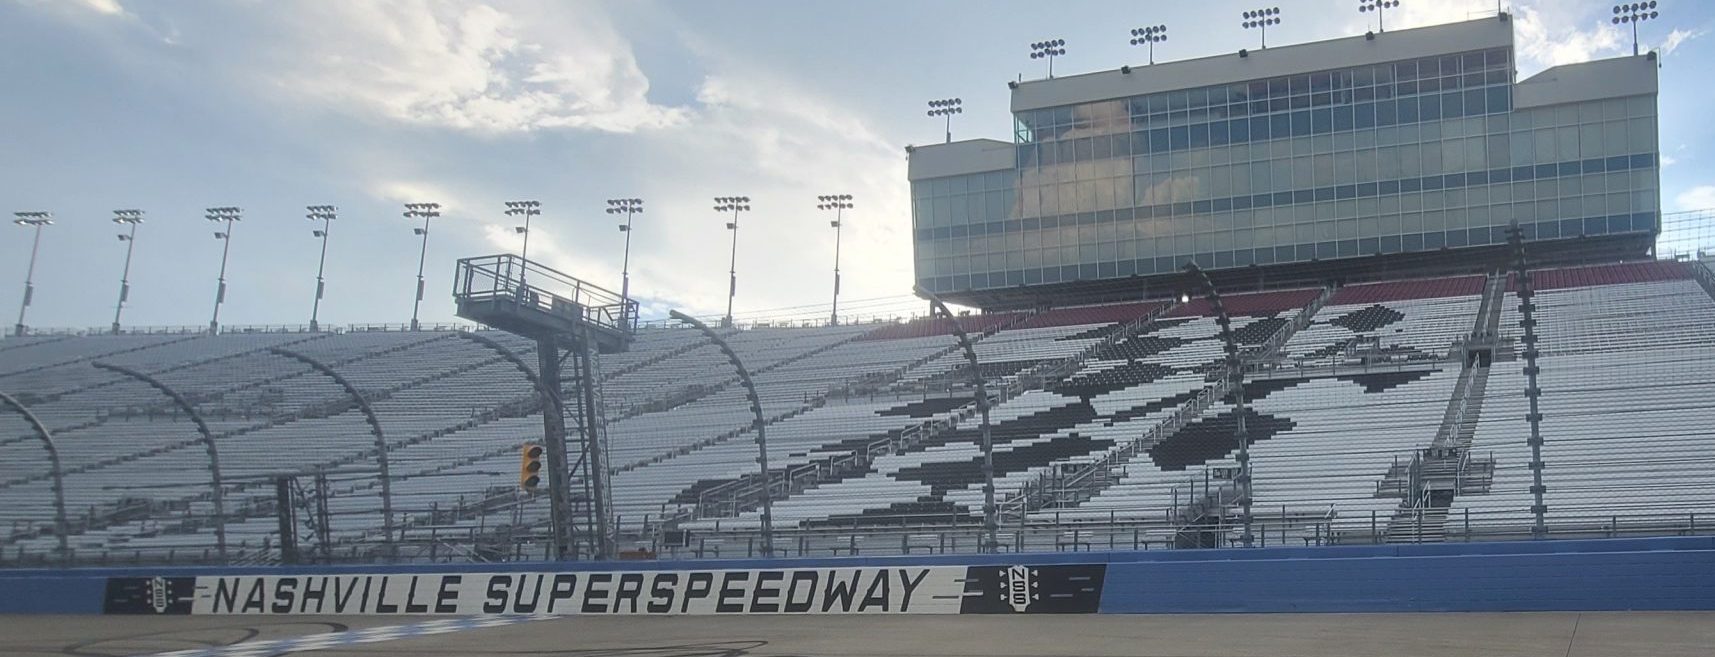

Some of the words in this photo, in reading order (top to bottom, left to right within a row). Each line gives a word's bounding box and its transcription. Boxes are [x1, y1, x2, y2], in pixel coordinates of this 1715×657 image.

[212, 575, 463, 614] NASHVILLE
[482, 568, 931, 614] SUPERSPEEDWAY
[1011, 568, 1026, 604] NSS
